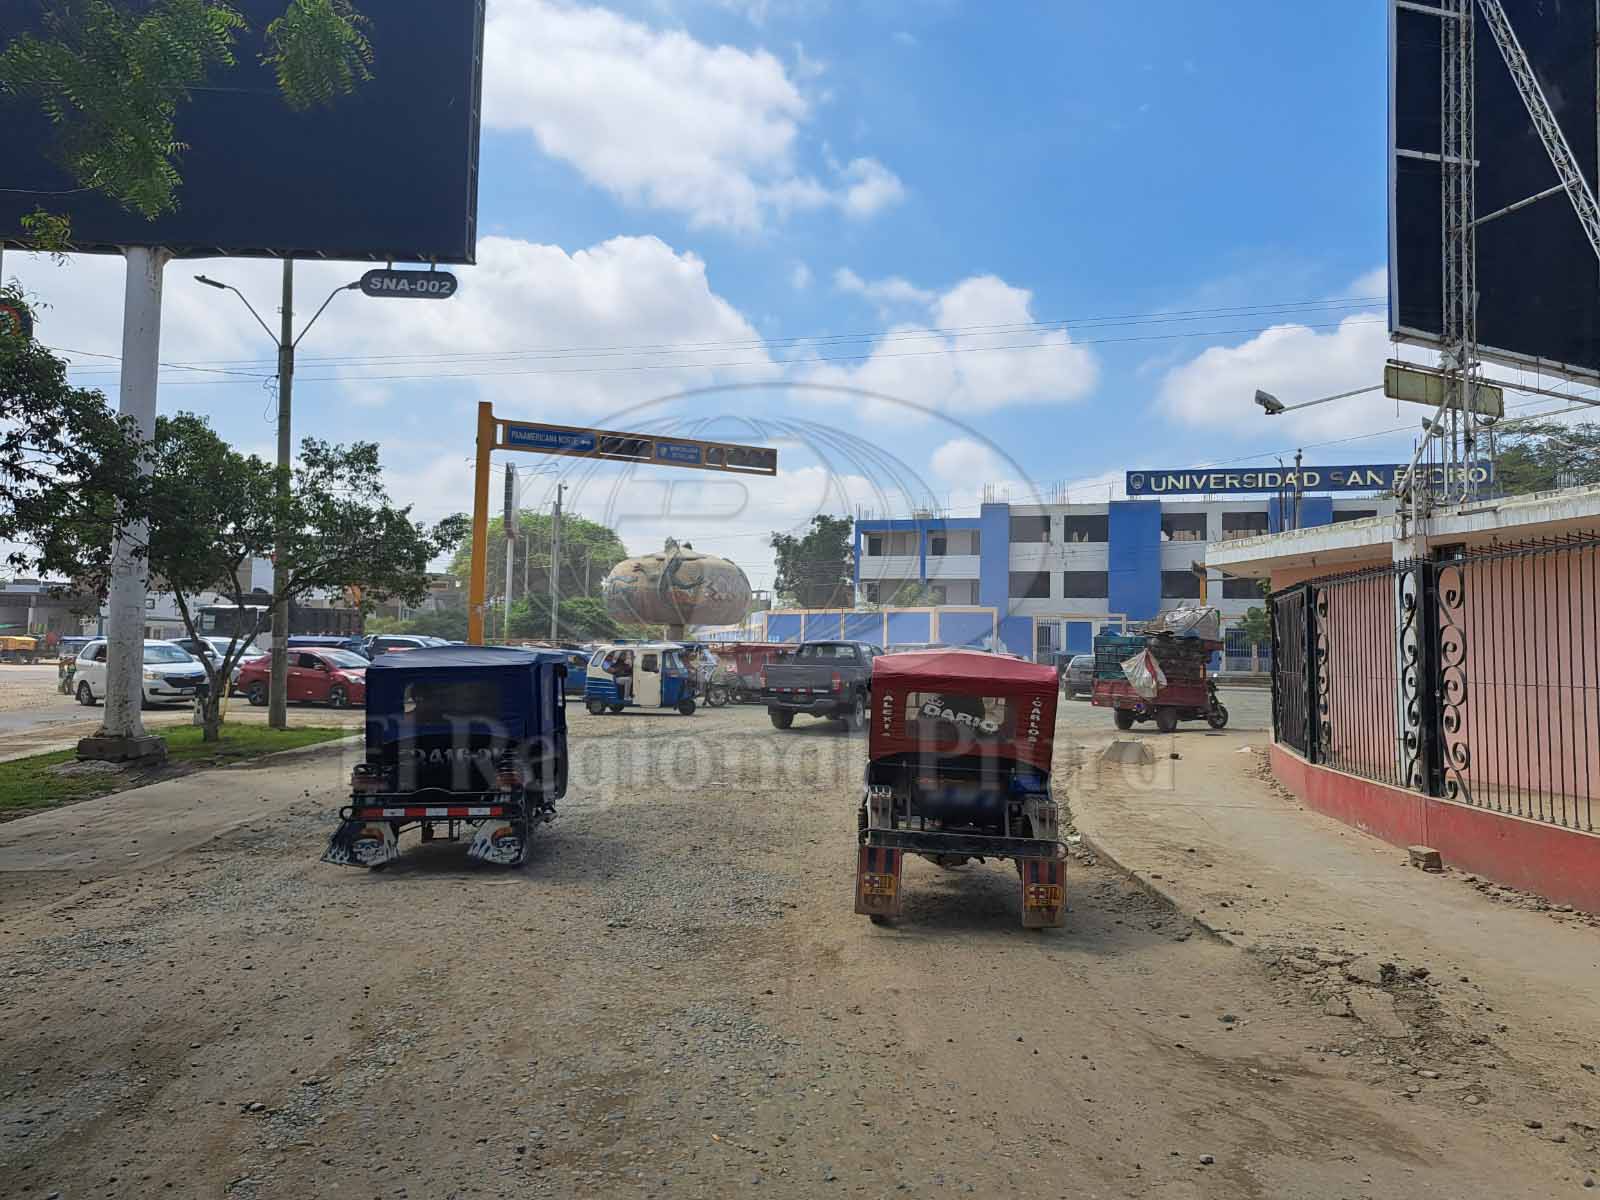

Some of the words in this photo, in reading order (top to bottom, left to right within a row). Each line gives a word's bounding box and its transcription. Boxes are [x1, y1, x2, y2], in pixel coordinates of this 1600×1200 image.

[369, 277, 451, 294] SNA-002
[1150, 471, 1321, 492] UNIVERSIDAD
[1329, 469, 1385, 487] SAN
[923, 703, 999, 733] DARIO
